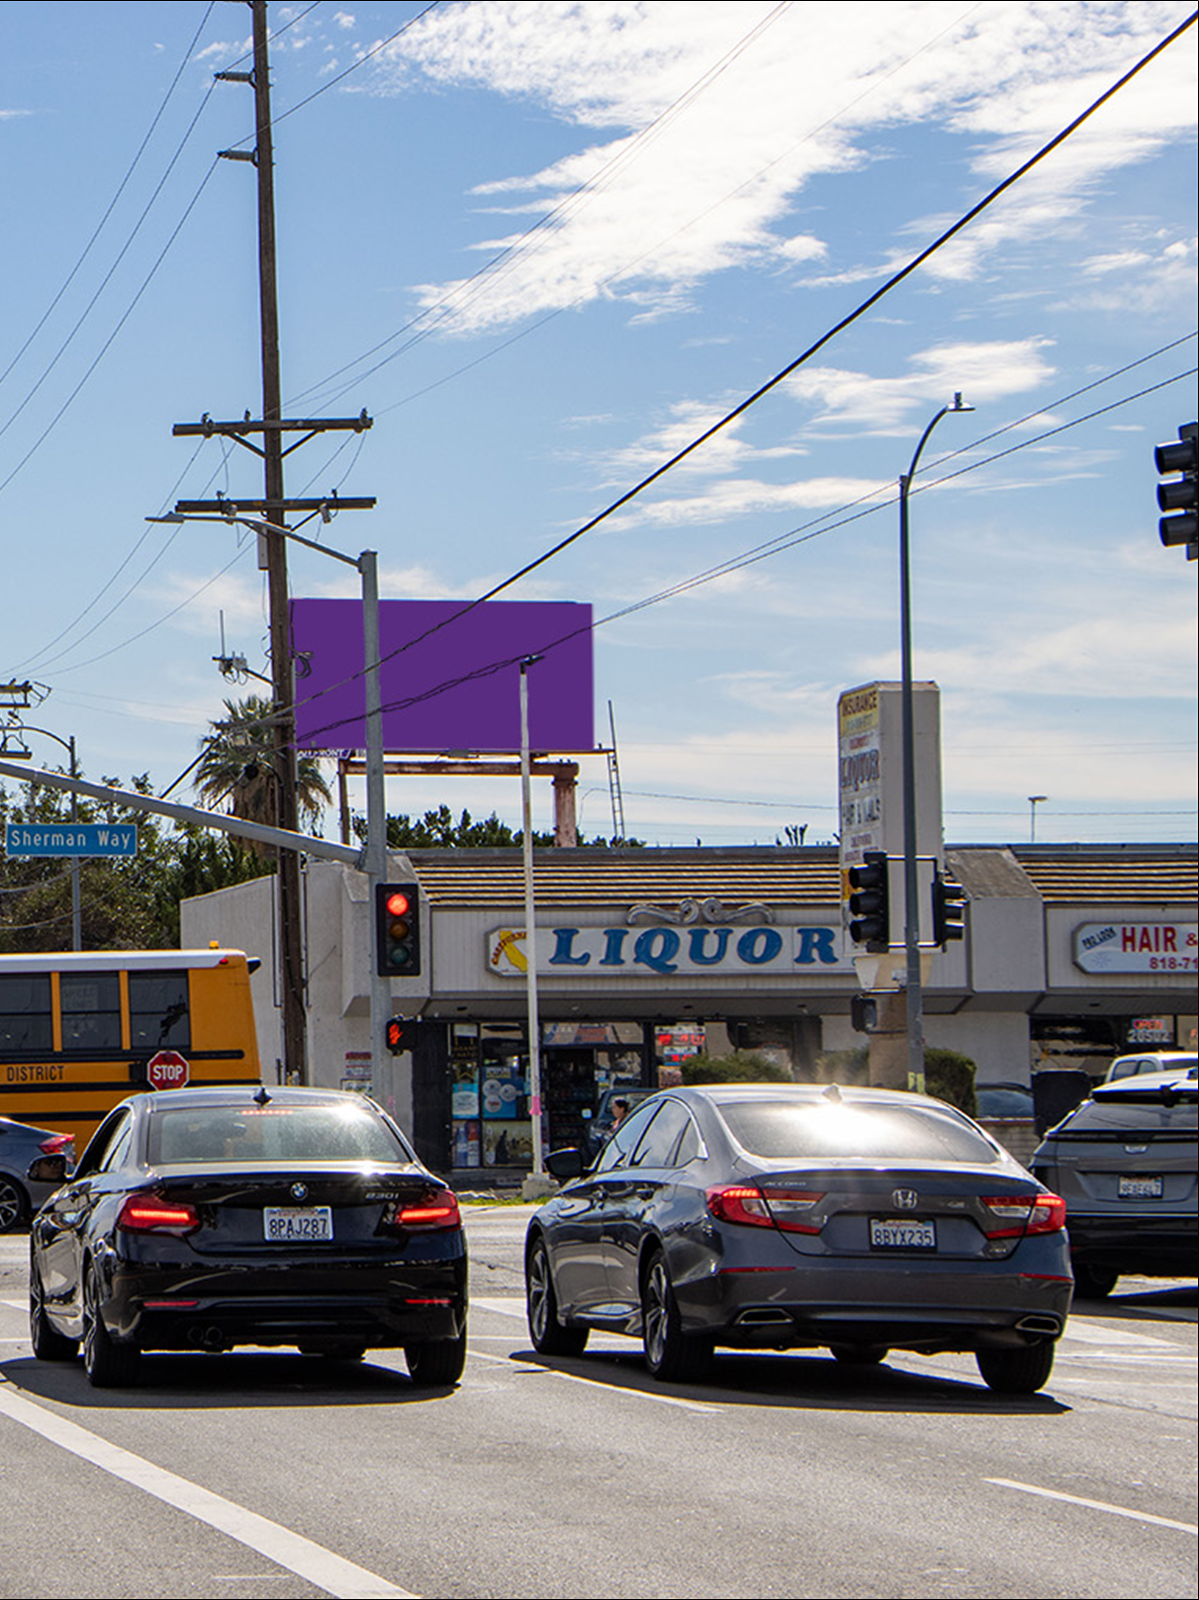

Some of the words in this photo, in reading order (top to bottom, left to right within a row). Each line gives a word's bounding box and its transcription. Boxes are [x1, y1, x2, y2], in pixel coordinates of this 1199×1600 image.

[840, 749, 880, 792] LIQUOR
[11, 829, 86, 847] Sherman
[97, 829, 131, 850] Way
[1121, 926, 1178, 953] HAIR
[1185, 932, 1198, 947] &
[549, 928, 839, 973] LIQUOR
[1133, 1020, 1164, 1030] OPEN
[7, 1065, 65, 1082] DISTRICT
[153, 1064, 184, 1080] STOP
[269, 1218, 328, 1235] 8PAJ287
[874, 1228, 932, 1246] 8BYX235
